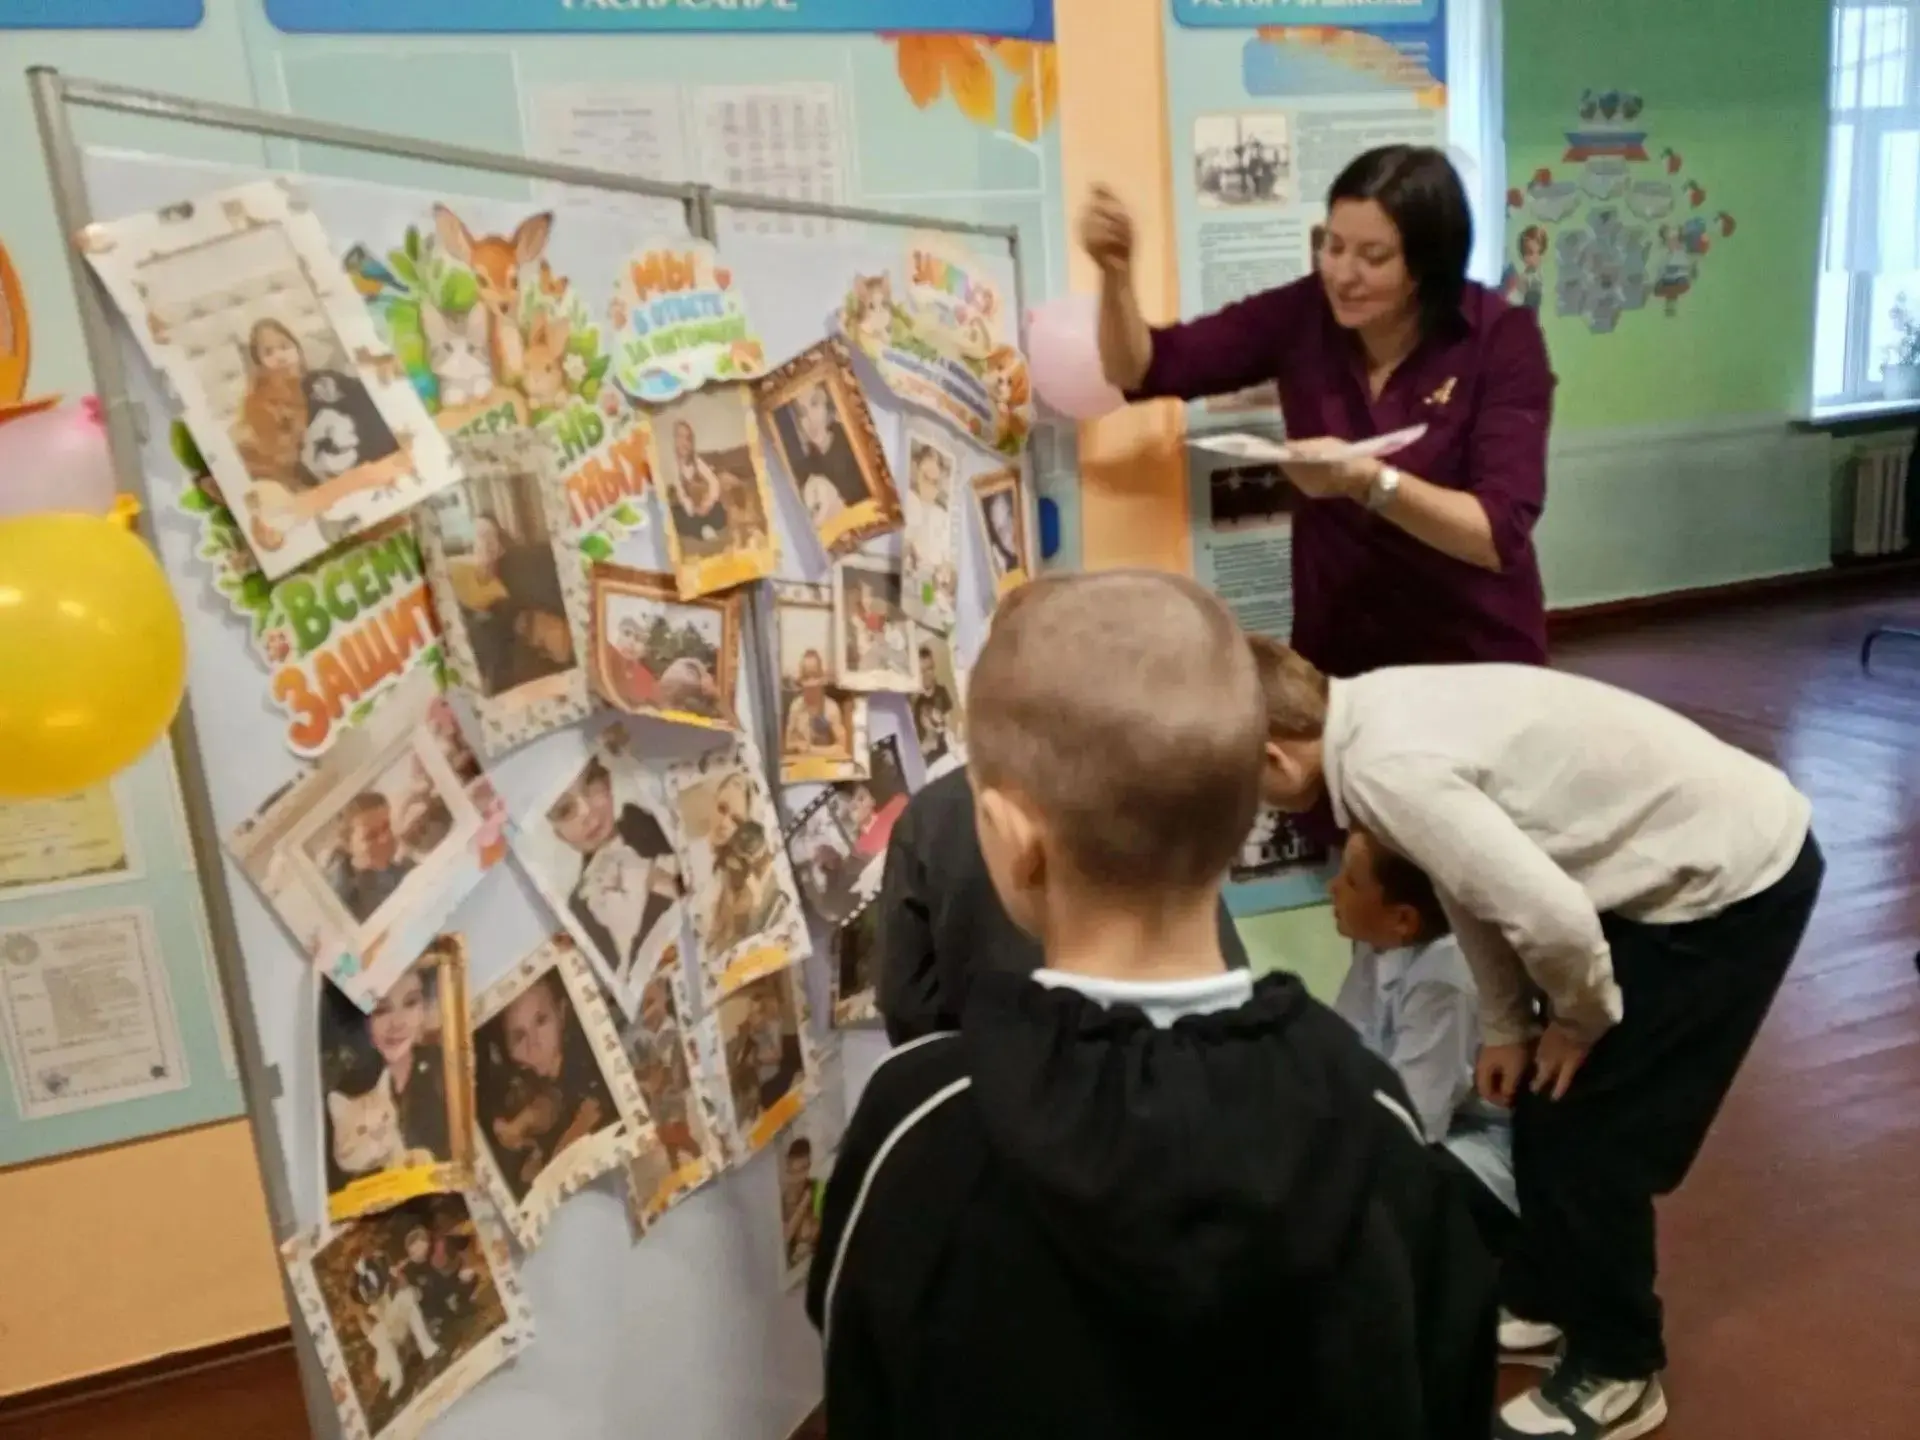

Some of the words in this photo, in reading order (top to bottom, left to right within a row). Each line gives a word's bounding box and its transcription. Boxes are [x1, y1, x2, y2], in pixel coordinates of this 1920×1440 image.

[273, 582, 441, 749] ЗАЩИТ
[565, 427, 655, 528] ТНЫХ
[281, 530, 425, 658] ВСЕМ
